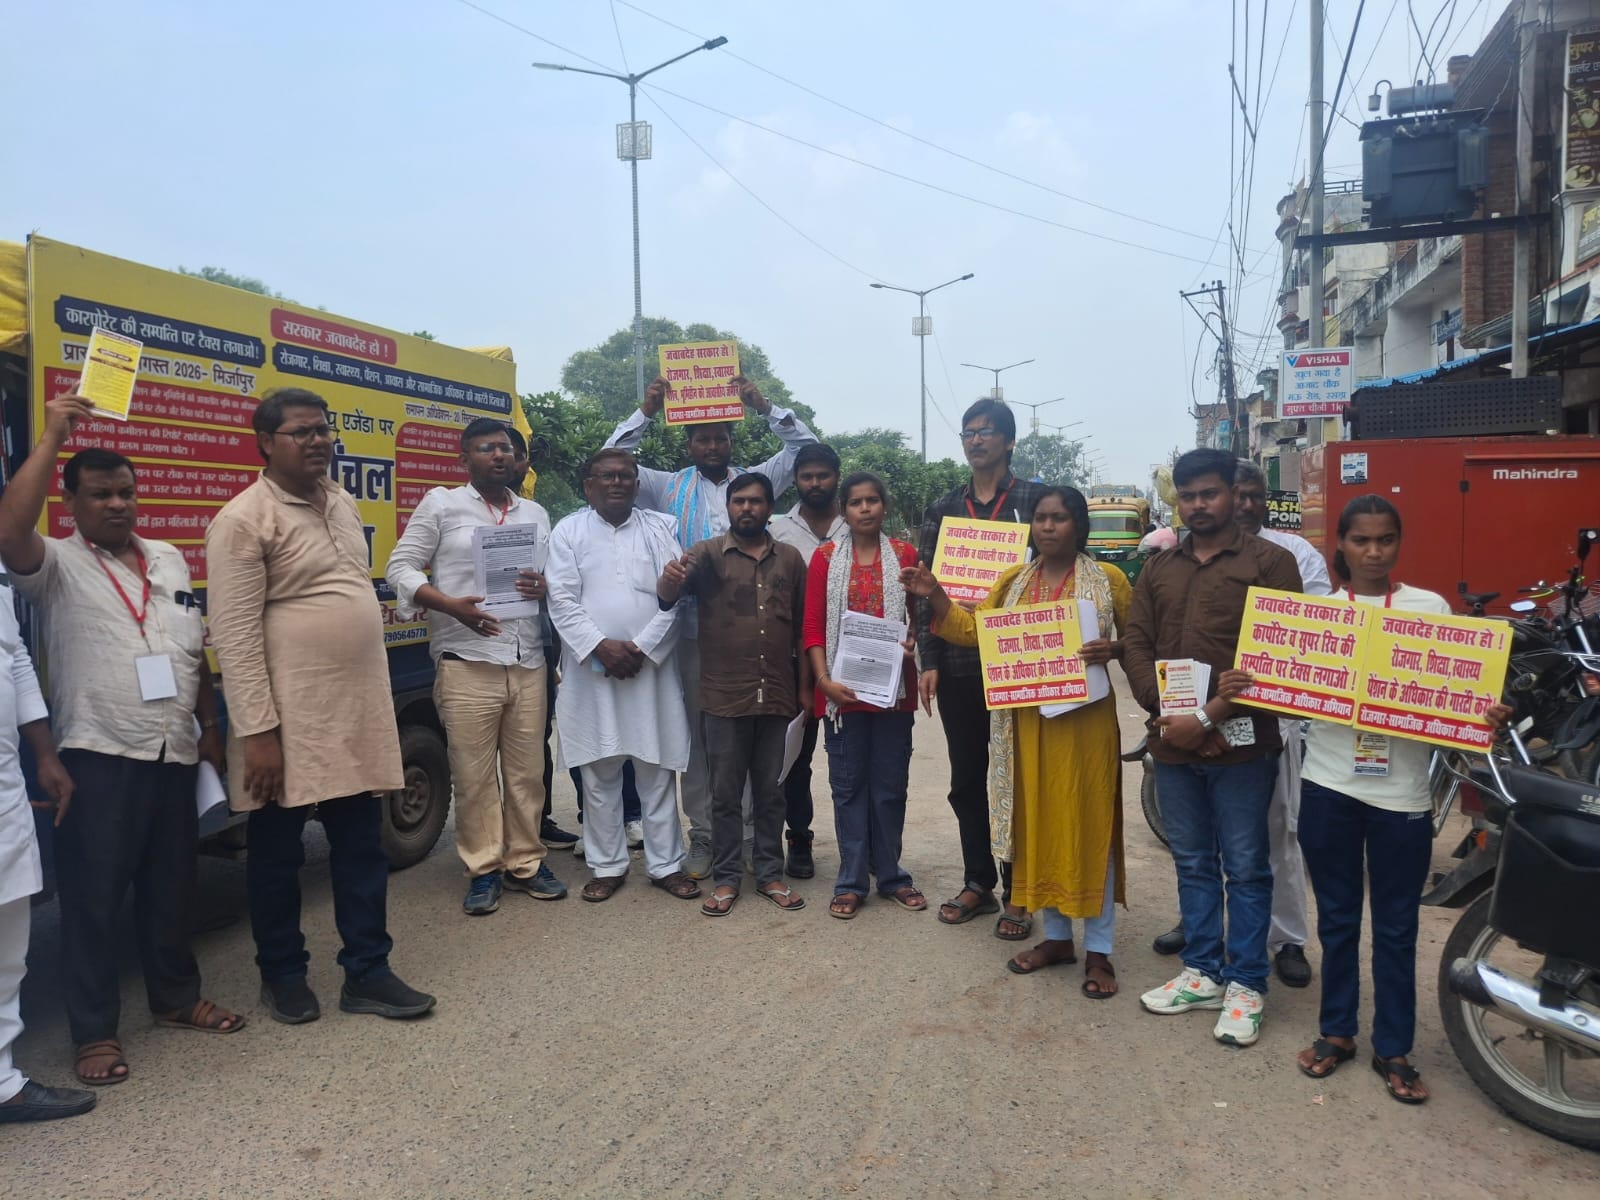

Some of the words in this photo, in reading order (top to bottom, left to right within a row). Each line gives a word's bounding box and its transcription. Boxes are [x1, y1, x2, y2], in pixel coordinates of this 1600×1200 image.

[121, 315, 136, 335] की
[140, 322, 179, 343] सम्पत्ति
[181, 331, 195, 347] पर
[198, 329, 221, 351] टैक्स
[282, 320, 322, 341] सरकार
[324, 329, 366, 353] जवाबदेह
[369, 340, 380, 356] हो
[280, 350, 311, 371] रोजगार,
[312, 356, 334, 376] शिक्षा,
[665, 346, 695, 360] जवाबदेह
[697, 347, 719, 359] सरकार
[721, 344, 729, 357] हो
[1306, 355, 1342, 366] VISHAL
[138, 355, 169, 375] गस्त
[212, 363, 255, 394] मिर्जापुर
[342, 408, 374, 433] एजेंडा
[379, 418, 395, 436] पर
[153, 470, 163, 481] पर
[167, 469, 183, 481] रोक
[1493, 468, 1578, 480] Mahindra
[945, 525, 979, 540] जवाबदेह
[980, 530, 1007, 543] सरकार
[1008, 529, 1018, 544] हो
[997, 551, 1006, 562] पर
[1006, 549, 1019, 563] रोक
[955, 563, 966, 577] पदों
[967, 567, 976, 579] पर
[984, 611, 1021, 628] जवाबदेह
[1023, 609, 1053, 624] सरकार
[1255, 596, 1301, 617] जवाबदेह
[1303, 603, 1341, 623] सरकार
[1343, 605, 1357, 625] हो
[997, 635, 1023, 654] रोजगार,
[1289, 629, 1298, 648] व
[1299, 631, 1321, 656] सुपर
[1321, 629, 1339, 655] रिच
[1340, 633, 1356, 657] की
[1382, 617, 1434, 639] जवाबदेह
[1436, 624, 1478, 646] सरकार
[1479, 628, 1494, 648] हो
[986, 662, 1003, 682] पेंशन
[1003, 661, 1011, 681] के
[1012, 659, 1037, 680] अधिकार
[1037, 657, 1048, 677] की
[1048, 655, 1066, 676] गारंटी
[1391, 643, 1423, 675] रोजगार,
[1276, 658, 1289, 679] पर
[1289, 656, 1313, 683] टैक्स
[1313, 665, 1350, 690] लगाओ
[1294, 692, 1321, 711] अधिकार
[1322, 697, 1353, 716] अभियान
[1367, 673, 1388, 699] पेंशन
[1388, 677, 1399, 701] के
[1399, 680, 1435, 708] अधिकार
[1435, 685, 1449, 710] की
[1449, 689, 1474, 714] गारंटी
[1424, 718, 1457, 738] अधिकार
[1456, 724, 1489, 744] अभियान
